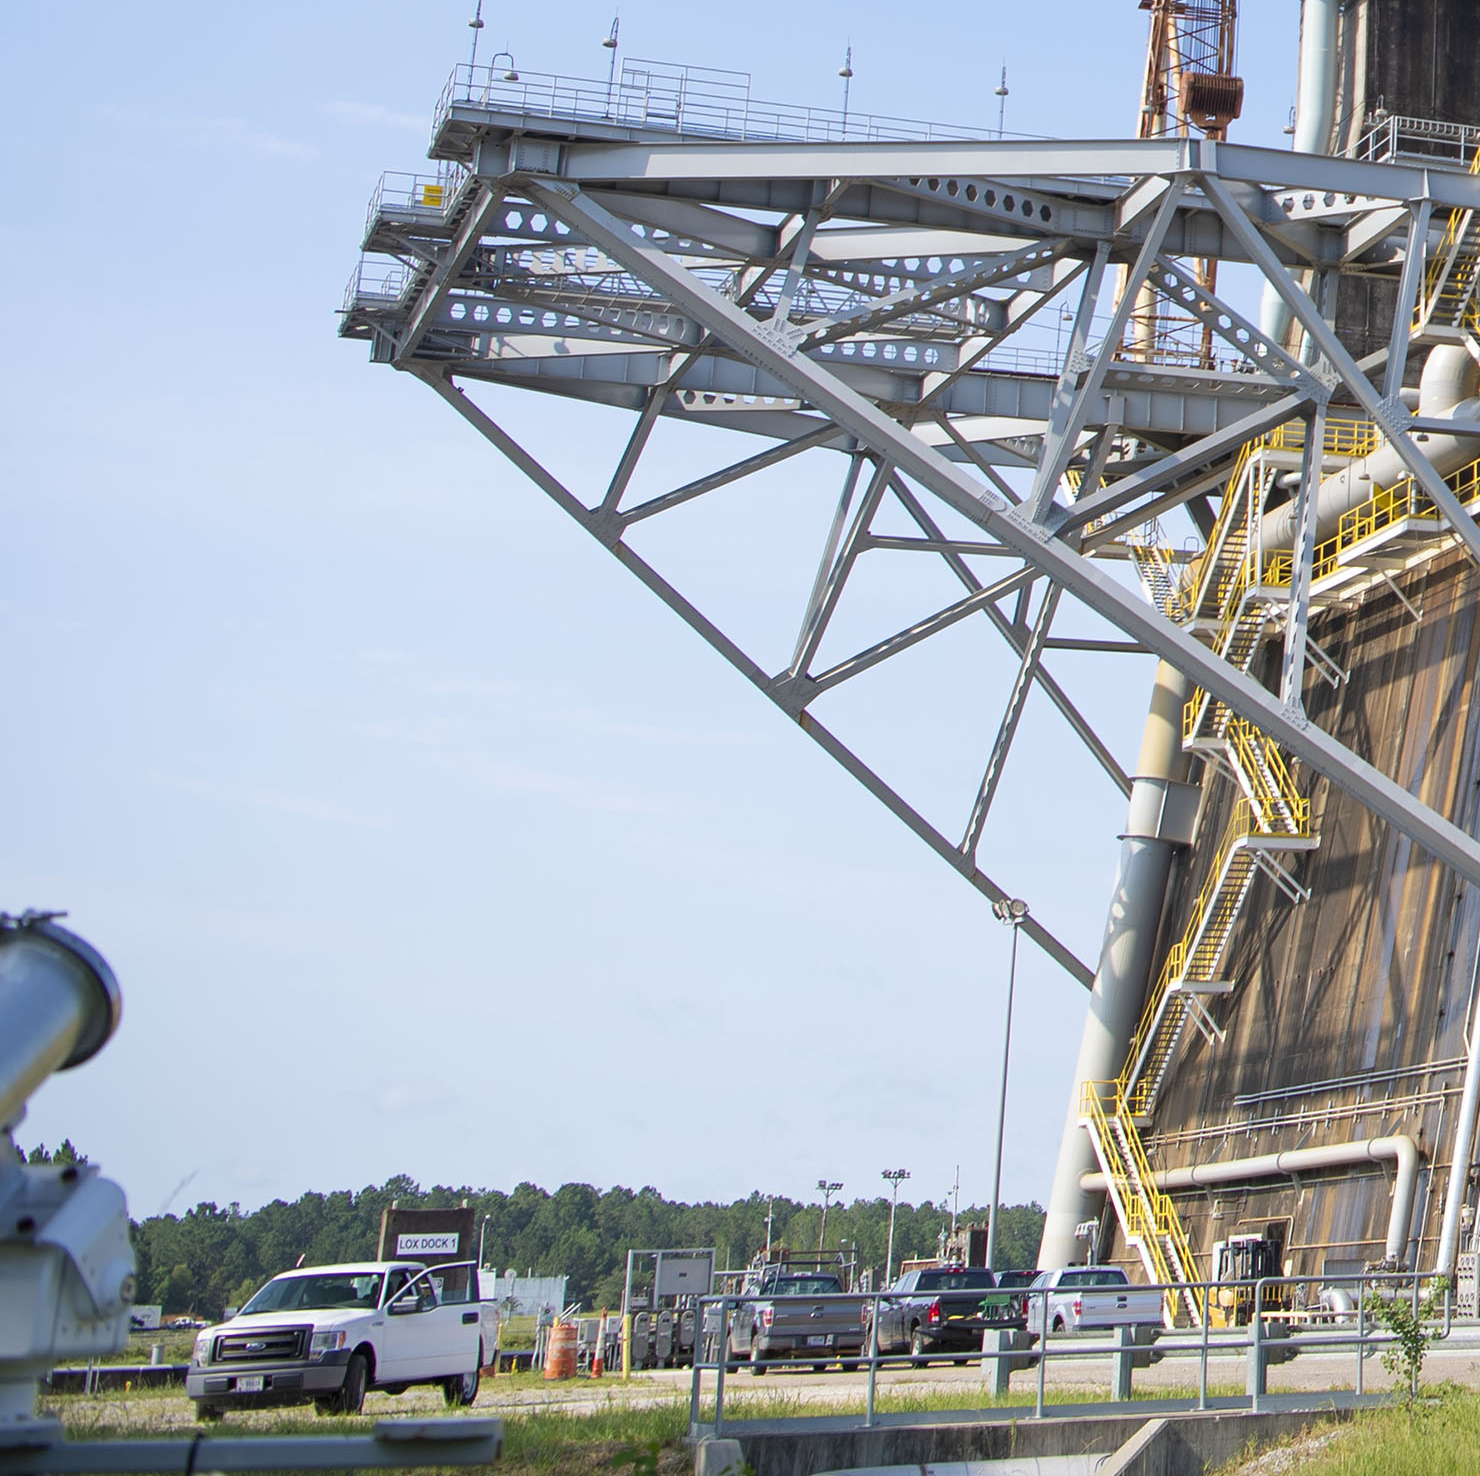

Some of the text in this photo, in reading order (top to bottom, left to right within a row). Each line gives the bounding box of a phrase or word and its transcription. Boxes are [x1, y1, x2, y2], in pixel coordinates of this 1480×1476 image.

[400, 1238, 457, 1250] LOX DOCK 1
